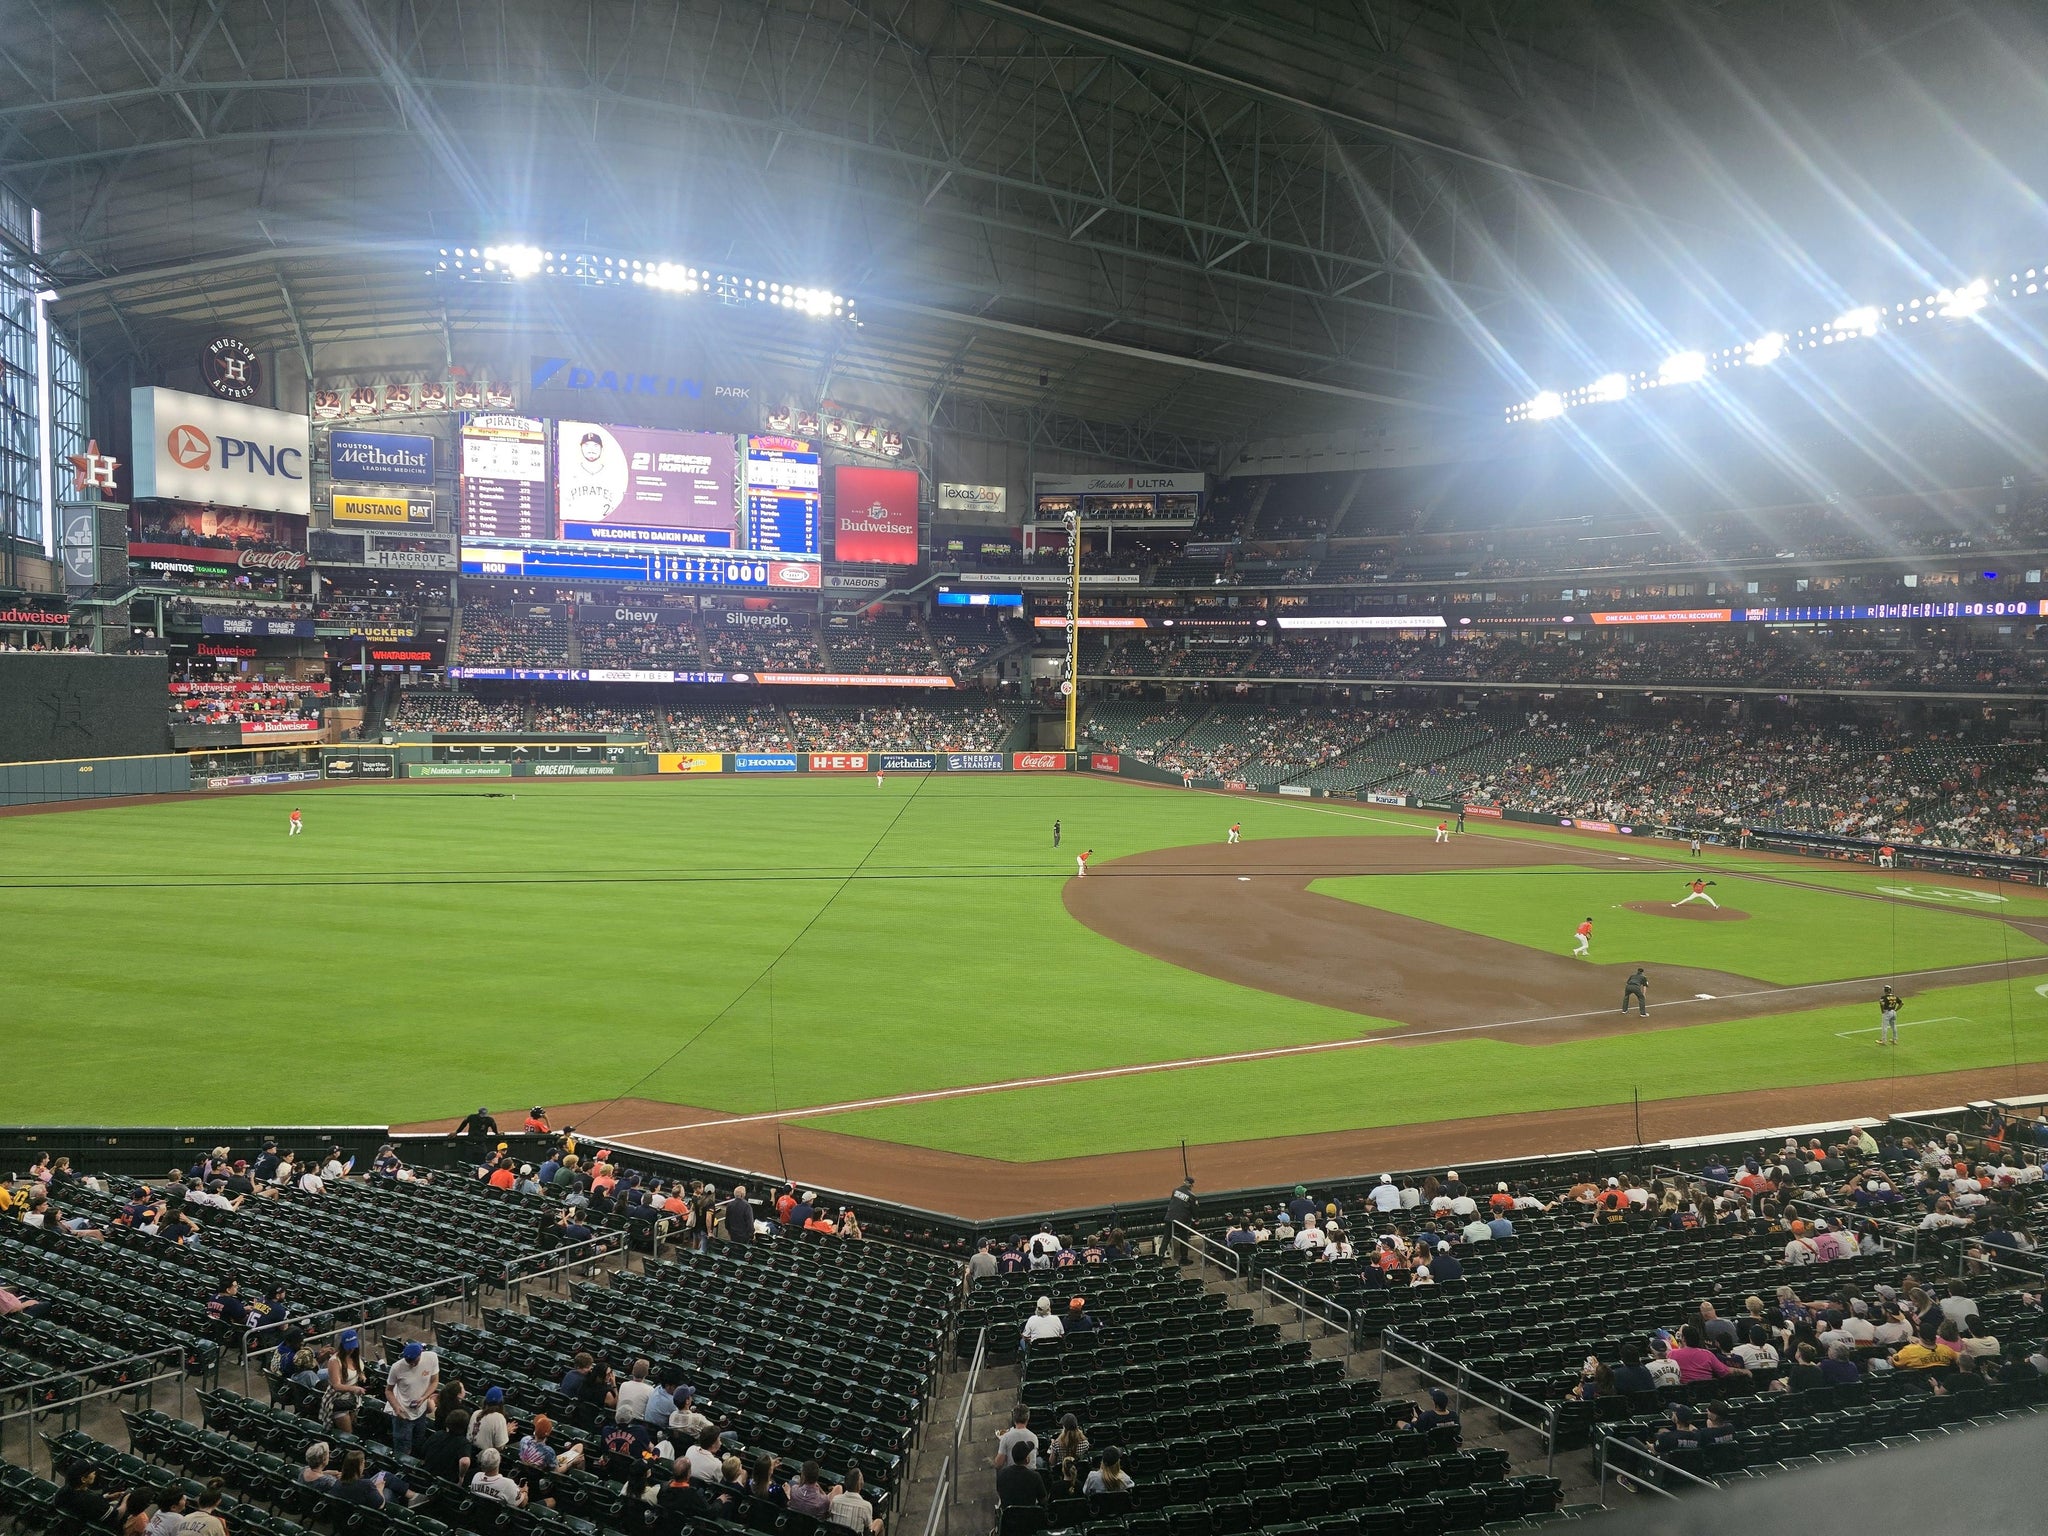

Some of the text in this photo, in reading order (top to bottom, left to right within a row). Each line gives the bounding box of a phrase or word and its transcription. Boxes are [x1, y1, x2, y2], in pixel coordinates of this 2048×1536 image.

[211, 339, 255, 361] HOUSTON
[224, 357, 246, 381] H
[213, 379, 254, 398] ASTROS
[421, 382, 445, 399] 33
[456, 380, 480, 398] 34
[487, 381, 511, 398] 42
[568, 367, 703, 400] DAIKIN
[315, 390, 340, 408] 32
[350, 387, 376, 404] 40
[386, 385, 410, 401] 25
[714, 386, 750, 398] PARK
[485, 416, 530, 431] PIRATES
[832, 418, 842, 433] 5
[860, 424, 871, 440] 7
[884, 430, 901, 445] 13
[336, 442, 374, 451] HOUSTON
[758, 435, 799, 451] ASTROS
[216, 436, 303, 480] PNC
[337, 449, 426, 468] Methodist
[631, 452, 651, 470] 2
[658, 453, 712, 465] SPENCER
[84, 453, 117, 488] H
[362, 465, 427, 475] LEADING MEDICINE
[658, 462, 709, 475] HORWITZ
[1087, 479, 1174, 490] Michelob ULTRA
[943, 484, 1002, 504] Texas Bay
[345, 502, 431, 518] MUSTANG CAT
[591, 528, 706, 543] WELCOME TO DAIKIN PARK
[238, 549, 305, 570] Coca-Cola
[379, 552, 447, 567] HARGROVE
[1066, 537, 1075, 573] ROOT
[151, 562, 194, 573] HORNITOS
[195, 566, 228, 575] TEQUILA BAR
[482, 563, 506, 573] HOU
[843, 578, 880, 588] NABORS
[1066, 576, 1074, 588] 4
[0, 607, 71, 624] udweiser
[615, 608, 789, 626] Chevy Silverado
[1867, 607, 1875, 616] R
[223, 619, 245, 628] CHASE
[267, 622, 288, 630] CHASE
[350, 628, 413, 637] PLUCKERS
[197, 643, 257, 657] Budweiser
[372, 651, 431, 661] WHATABURGER
[1065, 623, 1074, 681] CHIKIN
[570, 669, 579, 680] K
[190, 683, 237, 693] Budweiser
[262, 683, 312, 692] Budweiser
[265, 721, 309, 732] Budweiser
[79, 765, 93, 774] 409
[813, 756, 864, 768] H-E-B
[885, 758, 932, 769] Methodist
[963, 761, 1002, 769] TRANSFER
[431, 767, 462, 775] National
[535, 765, 558, 775] SPACE
[558, 765, 574, 775] CITY
[589, 767, 615, 775] NETWORK
[471, 1483, 500, 1498] ALVAREZ
